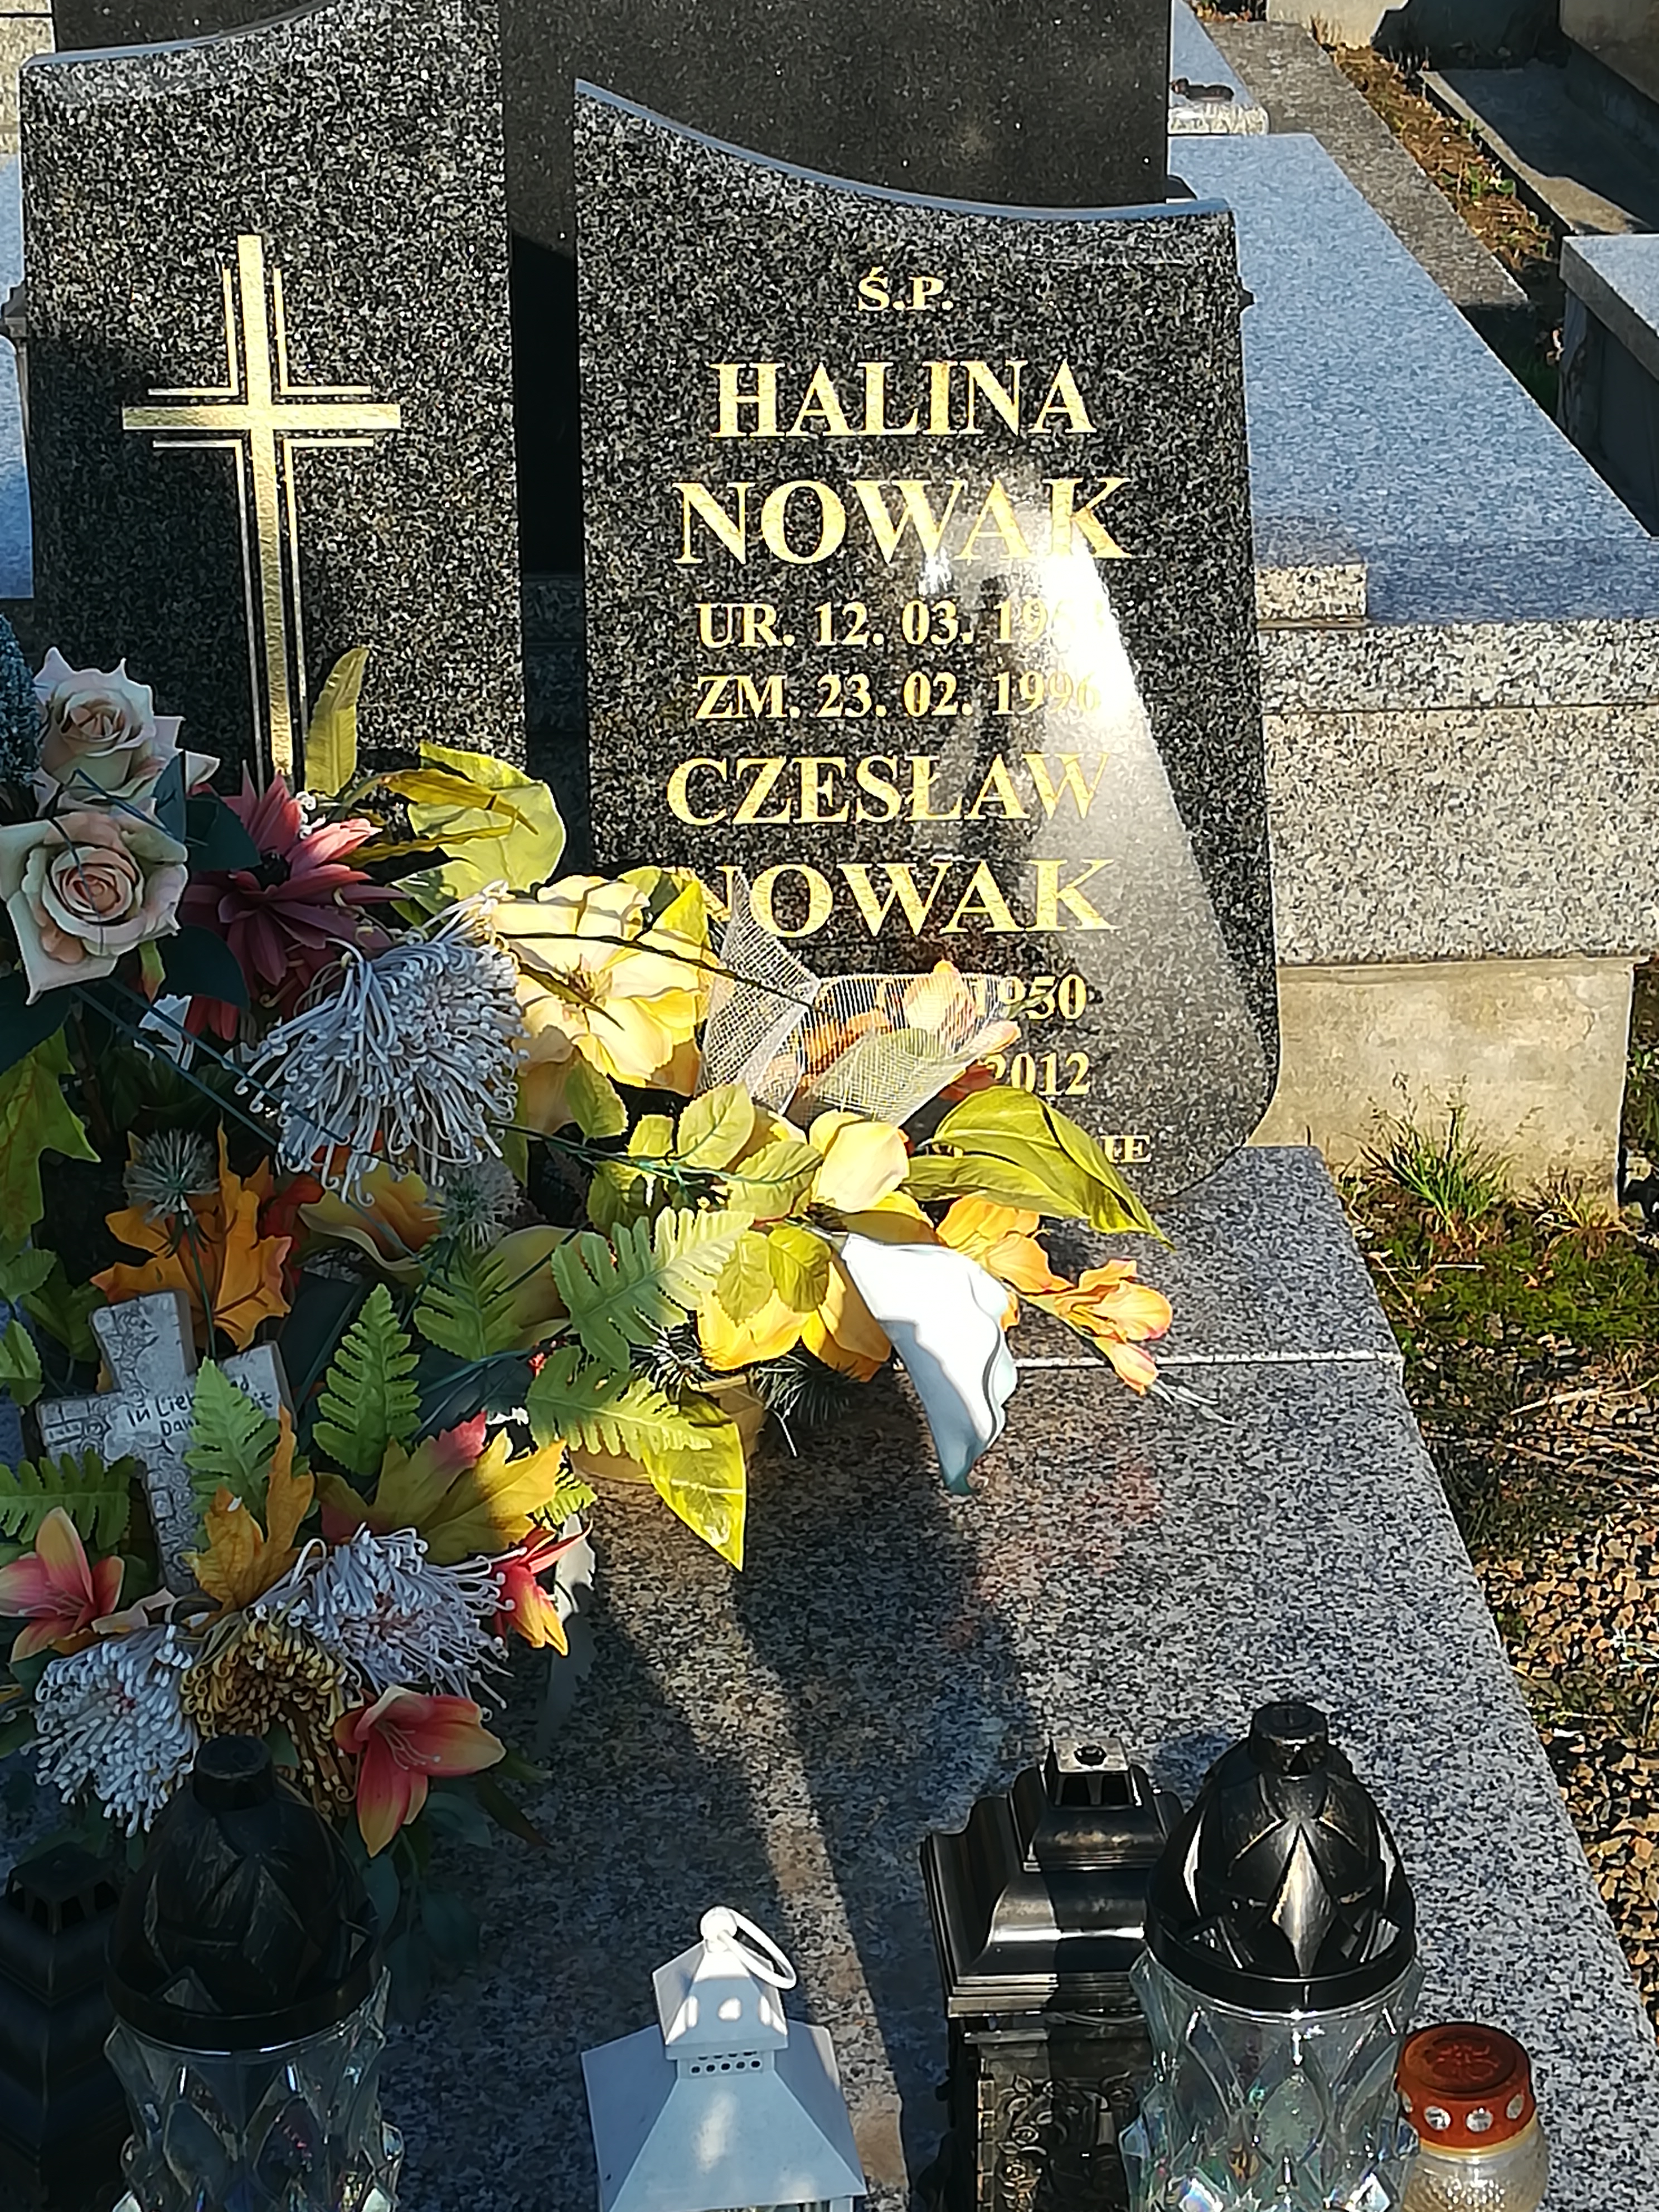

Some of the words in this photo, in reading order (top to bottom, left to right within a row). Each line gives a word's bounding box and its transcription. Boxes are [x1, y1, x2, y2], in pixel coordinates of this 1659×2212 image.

[857, 267, 954, 311] Ś.P.
[710, 359, 1097, 439] HALINA
[671, 478, 1132, 564] NOWAK
[695, 603, 795, 648] UR.
[814, 601, 884, 647] 12.
[901, 600, 974, 644] 03.
[695, 675, 799, 720] ZM.
[816, 673, 886, 718] 23.
[904, 671, 973, 717] 02.
[992, 671, 1102, 716] 1996
[667, 753, 1110, 826] CZESŁAW
